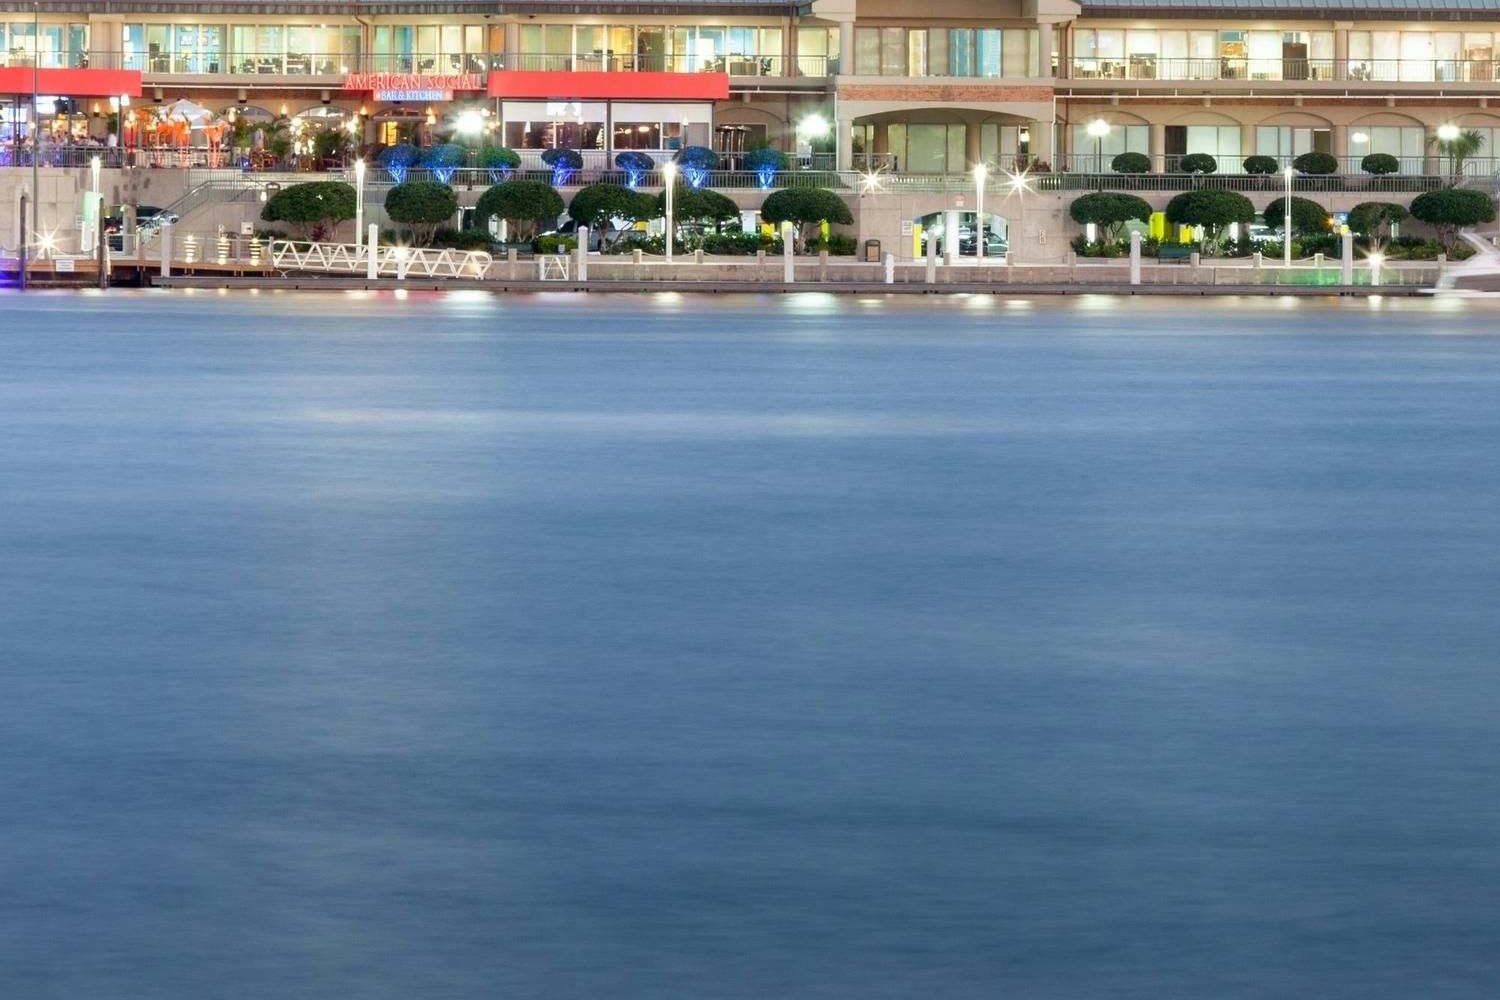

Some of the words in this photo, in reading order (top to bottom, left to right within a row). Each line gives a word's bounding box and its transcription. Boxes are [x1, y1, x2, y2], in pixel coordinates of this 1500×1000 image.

[345, 75, 421, 90] AMERICAN
[428, 74, 480, 90] SOCIAL
[381, 90, 396, 101] BAR
[397, 90, 404, 101] &
[405, 90, 443, 101] KITCHEN
